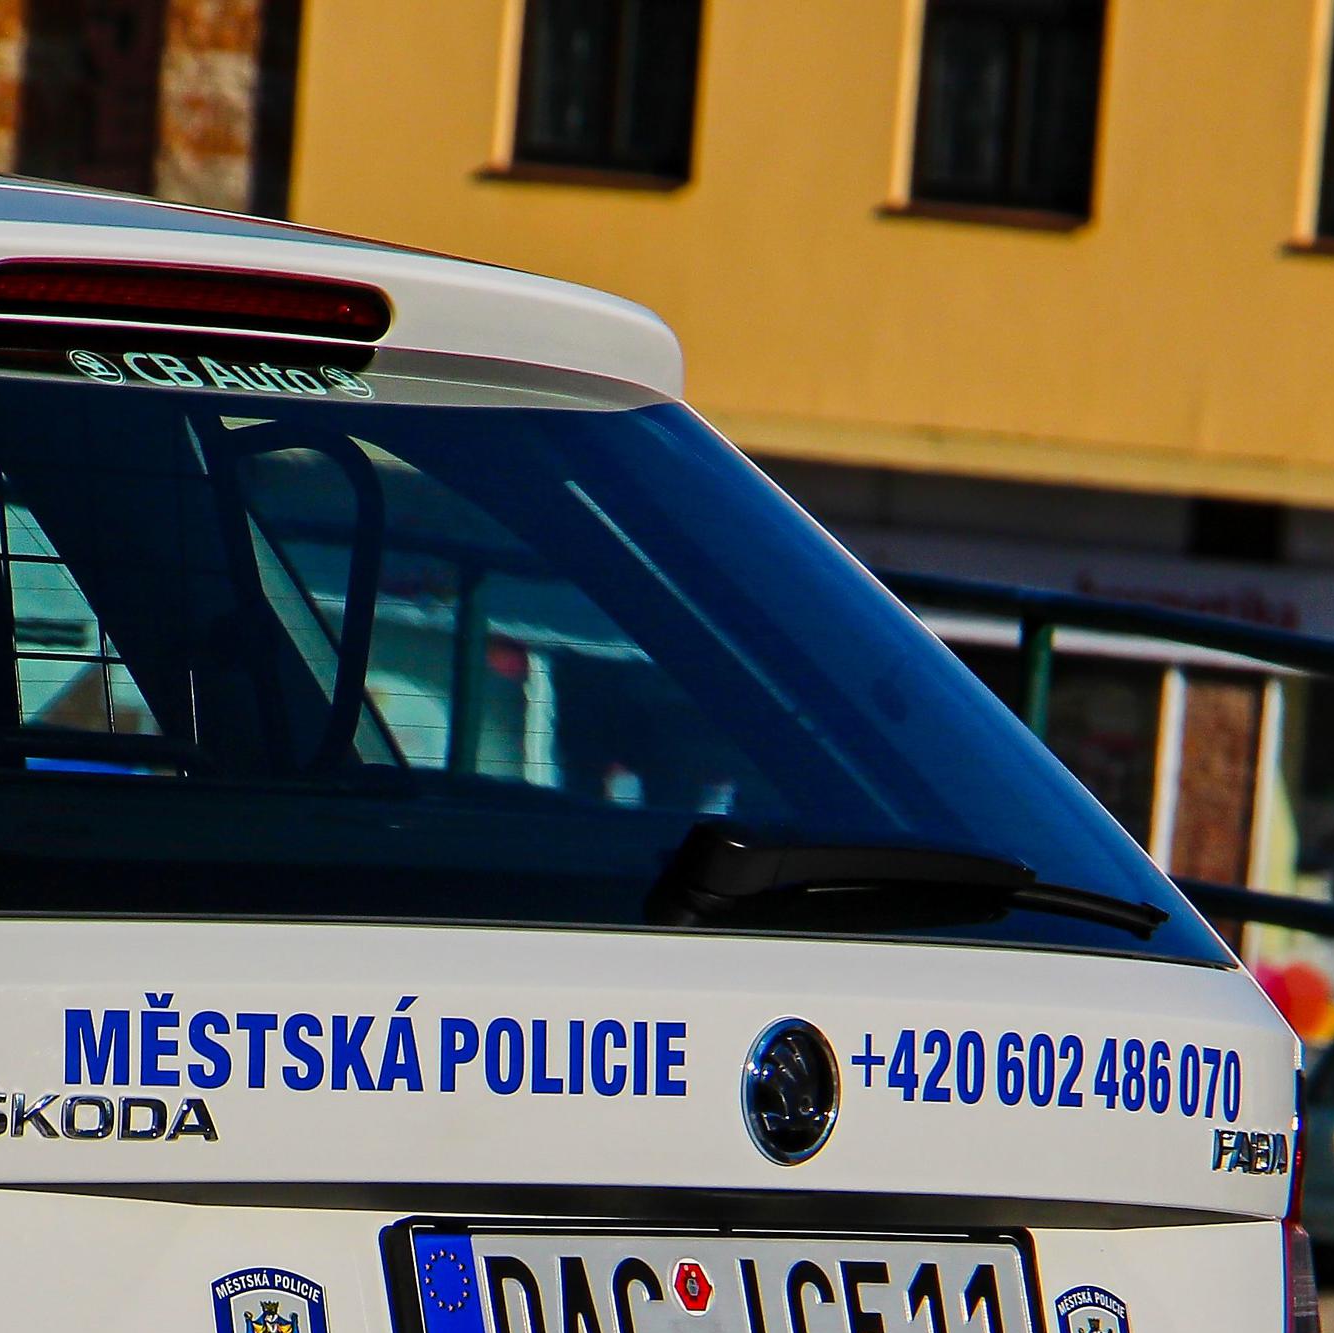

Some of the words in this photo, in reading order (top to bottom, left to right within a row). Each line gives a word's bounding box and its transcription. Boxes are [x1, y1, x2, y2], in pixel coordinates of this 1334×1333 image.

[123, 352, 203, 387] CB
[197, 355, 327, 394] Auto
[64, 992, 422, 1092] MĚSTSKÁ
[440, 1017, 687, 1096] POLICIE
[851, 1029, 985, 1104] +420
[996, 1032, 1084, 1108] 602
[1093, 1038, 1172, 1114] 486
[1179, 1043, 1241, 1122] 070
[215, 1269, 270, 1299] MĚSTSKÁ
[274, 1274, 321, 1303] POLICIE
[1057, 1288, 1093, 1316] MĚSTSKÁ
[1095, 1291, 1125, 1319] POLICIE
